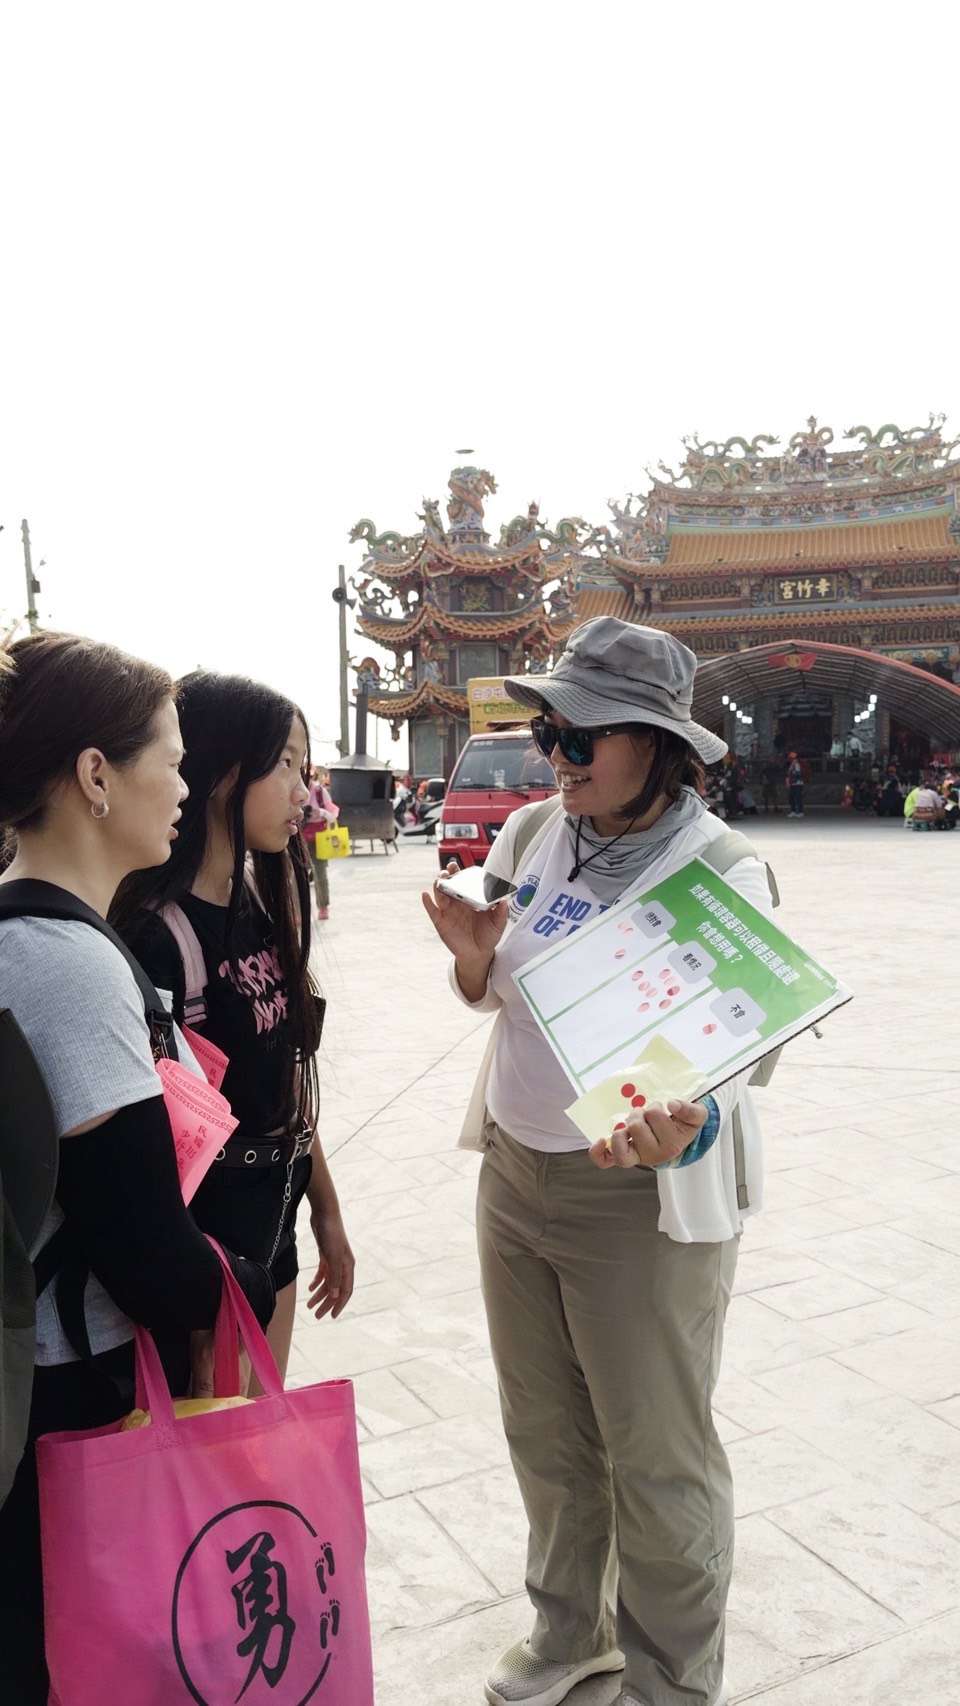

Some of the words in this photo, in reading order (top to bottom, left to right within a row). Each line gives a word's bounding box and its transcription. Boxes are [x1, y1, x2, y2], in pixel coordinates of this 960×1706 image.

[472, 687, 509, 700] 白沙屯
[549, 893, 592, 921] END
[533, 915, 565, 937] OF
[682, 952, 702, 971] 看情況
[729, 1004, 746, 1019] 不會
[226, 1531, 296, 1704] 勇
